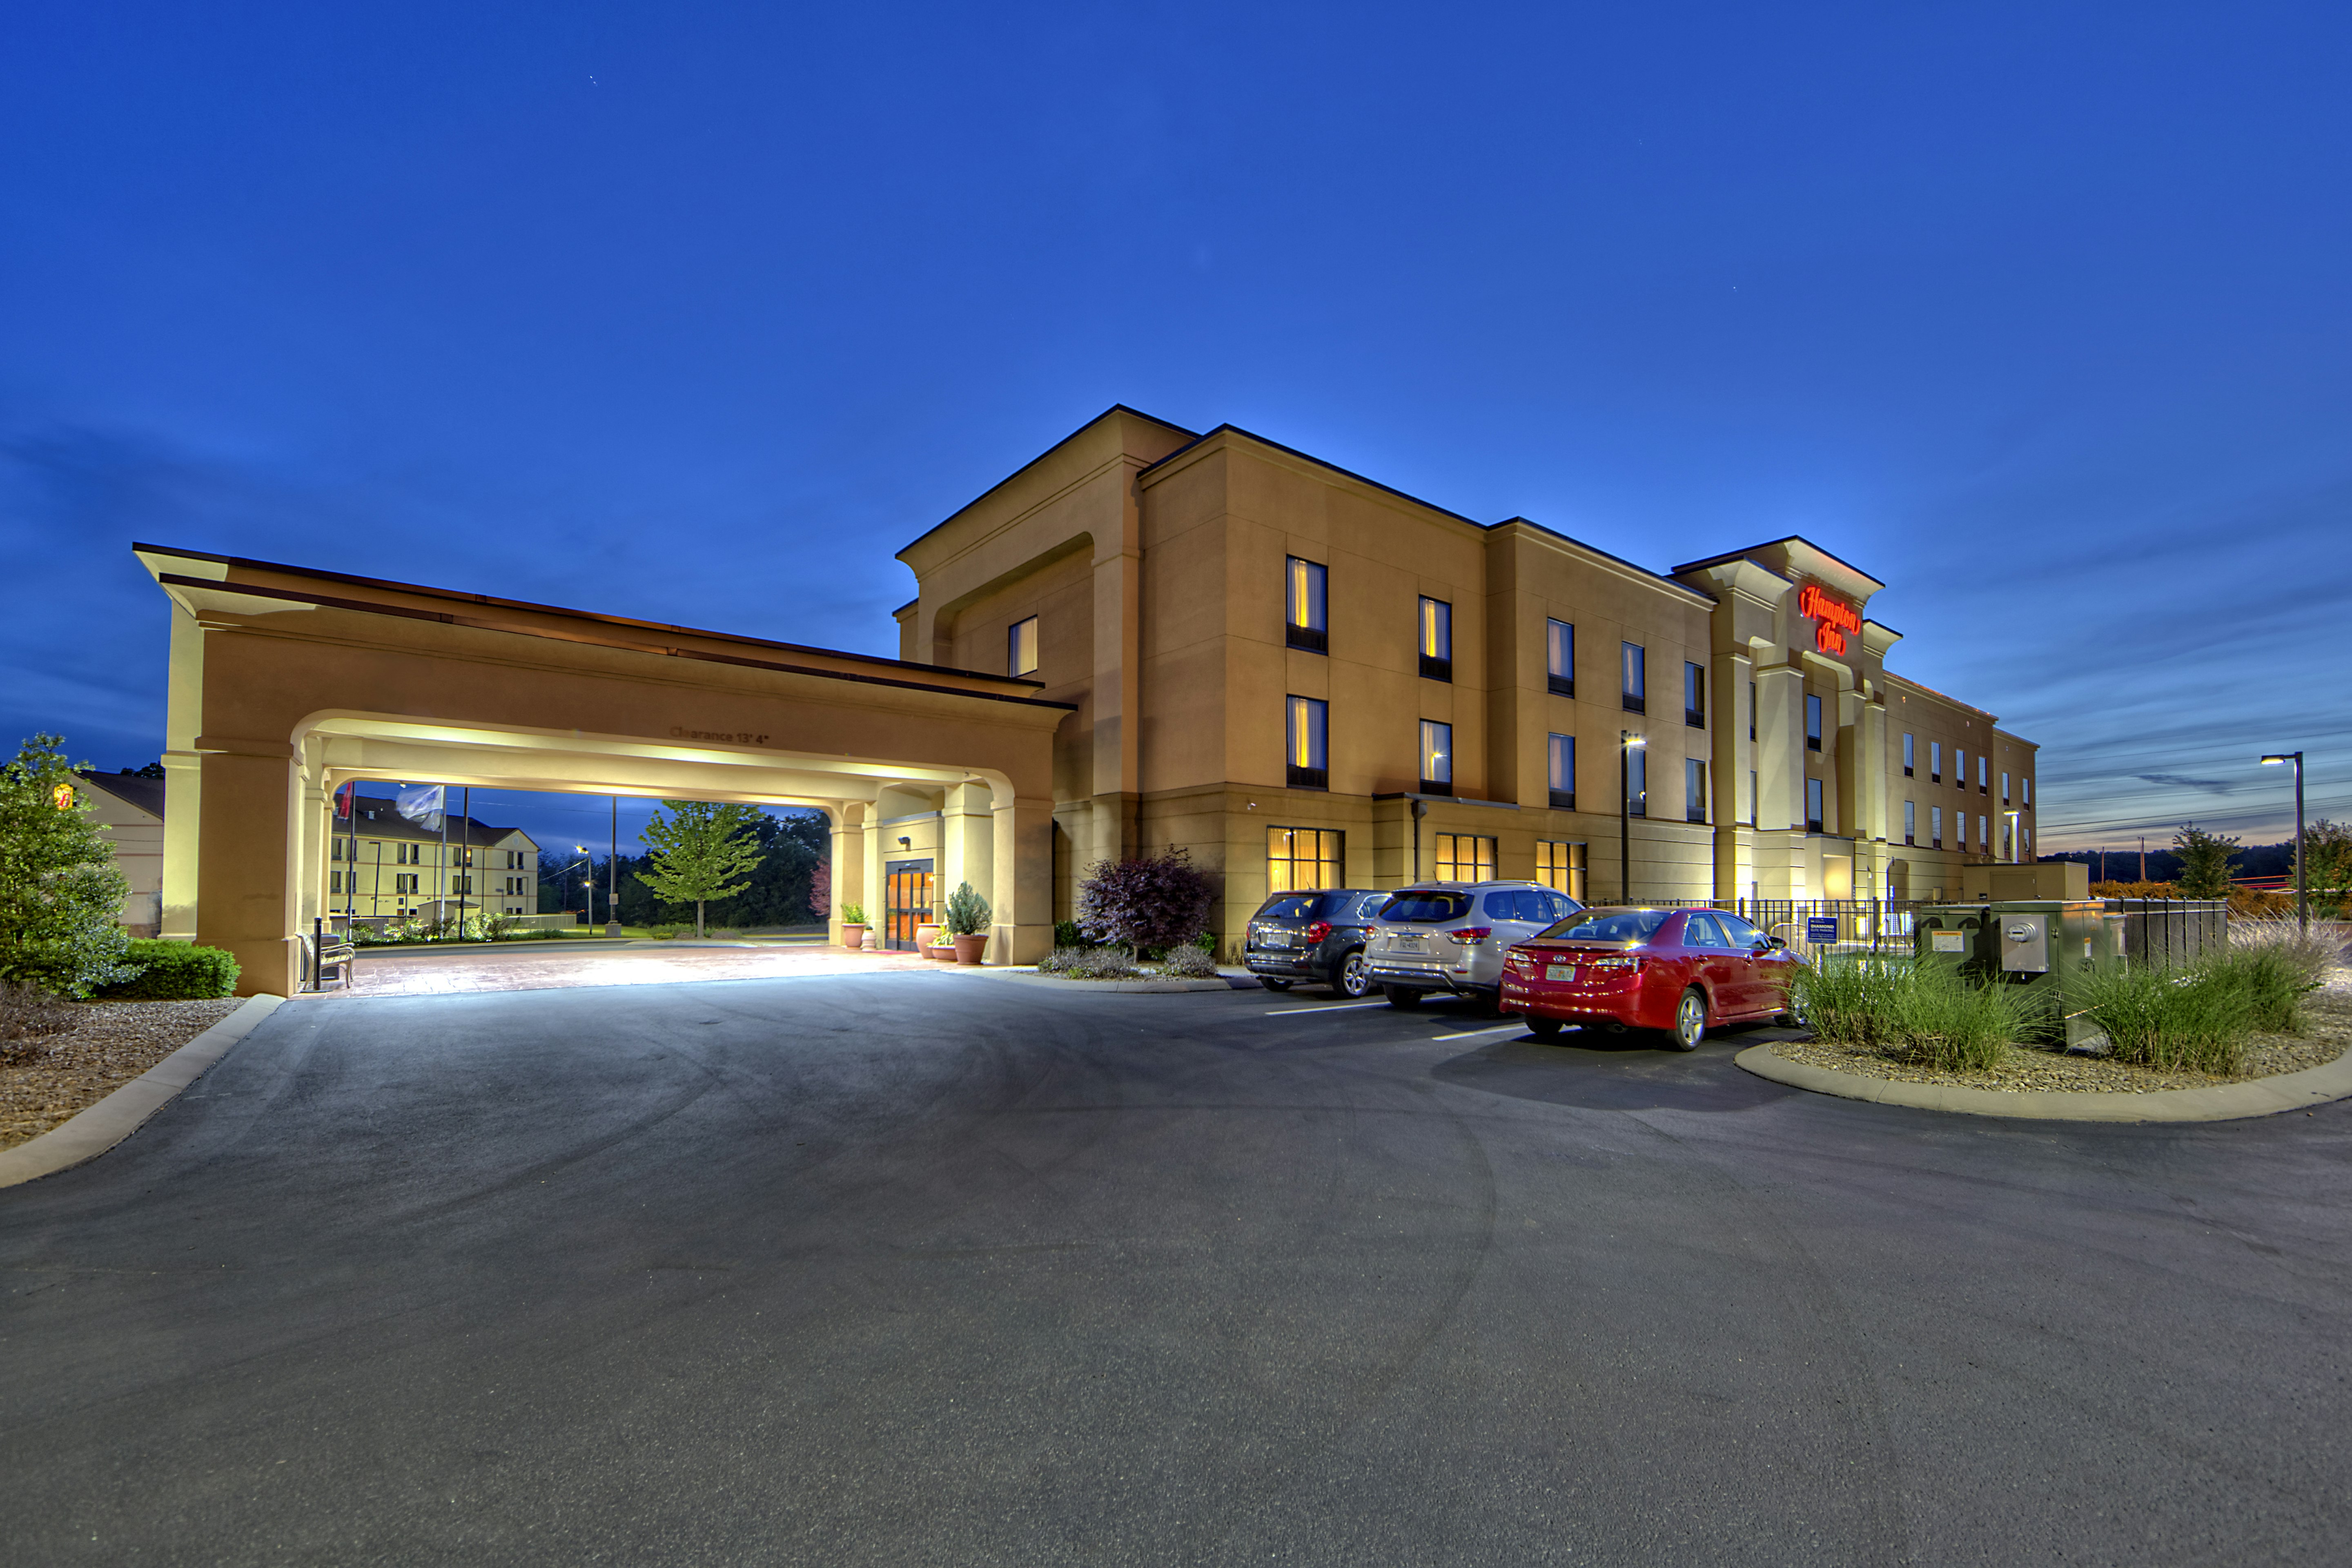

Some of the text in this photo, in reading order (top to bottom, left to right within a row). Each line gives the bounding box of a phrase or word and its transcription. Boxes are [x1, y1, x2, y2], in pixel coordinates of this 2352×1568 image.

[1800, 586, 1860, 636] Hampton
[1818, 621, 1846, 656] Inn
[669, 726, 733, 741] Clearance
[737, 733, 753, 743] 13'
